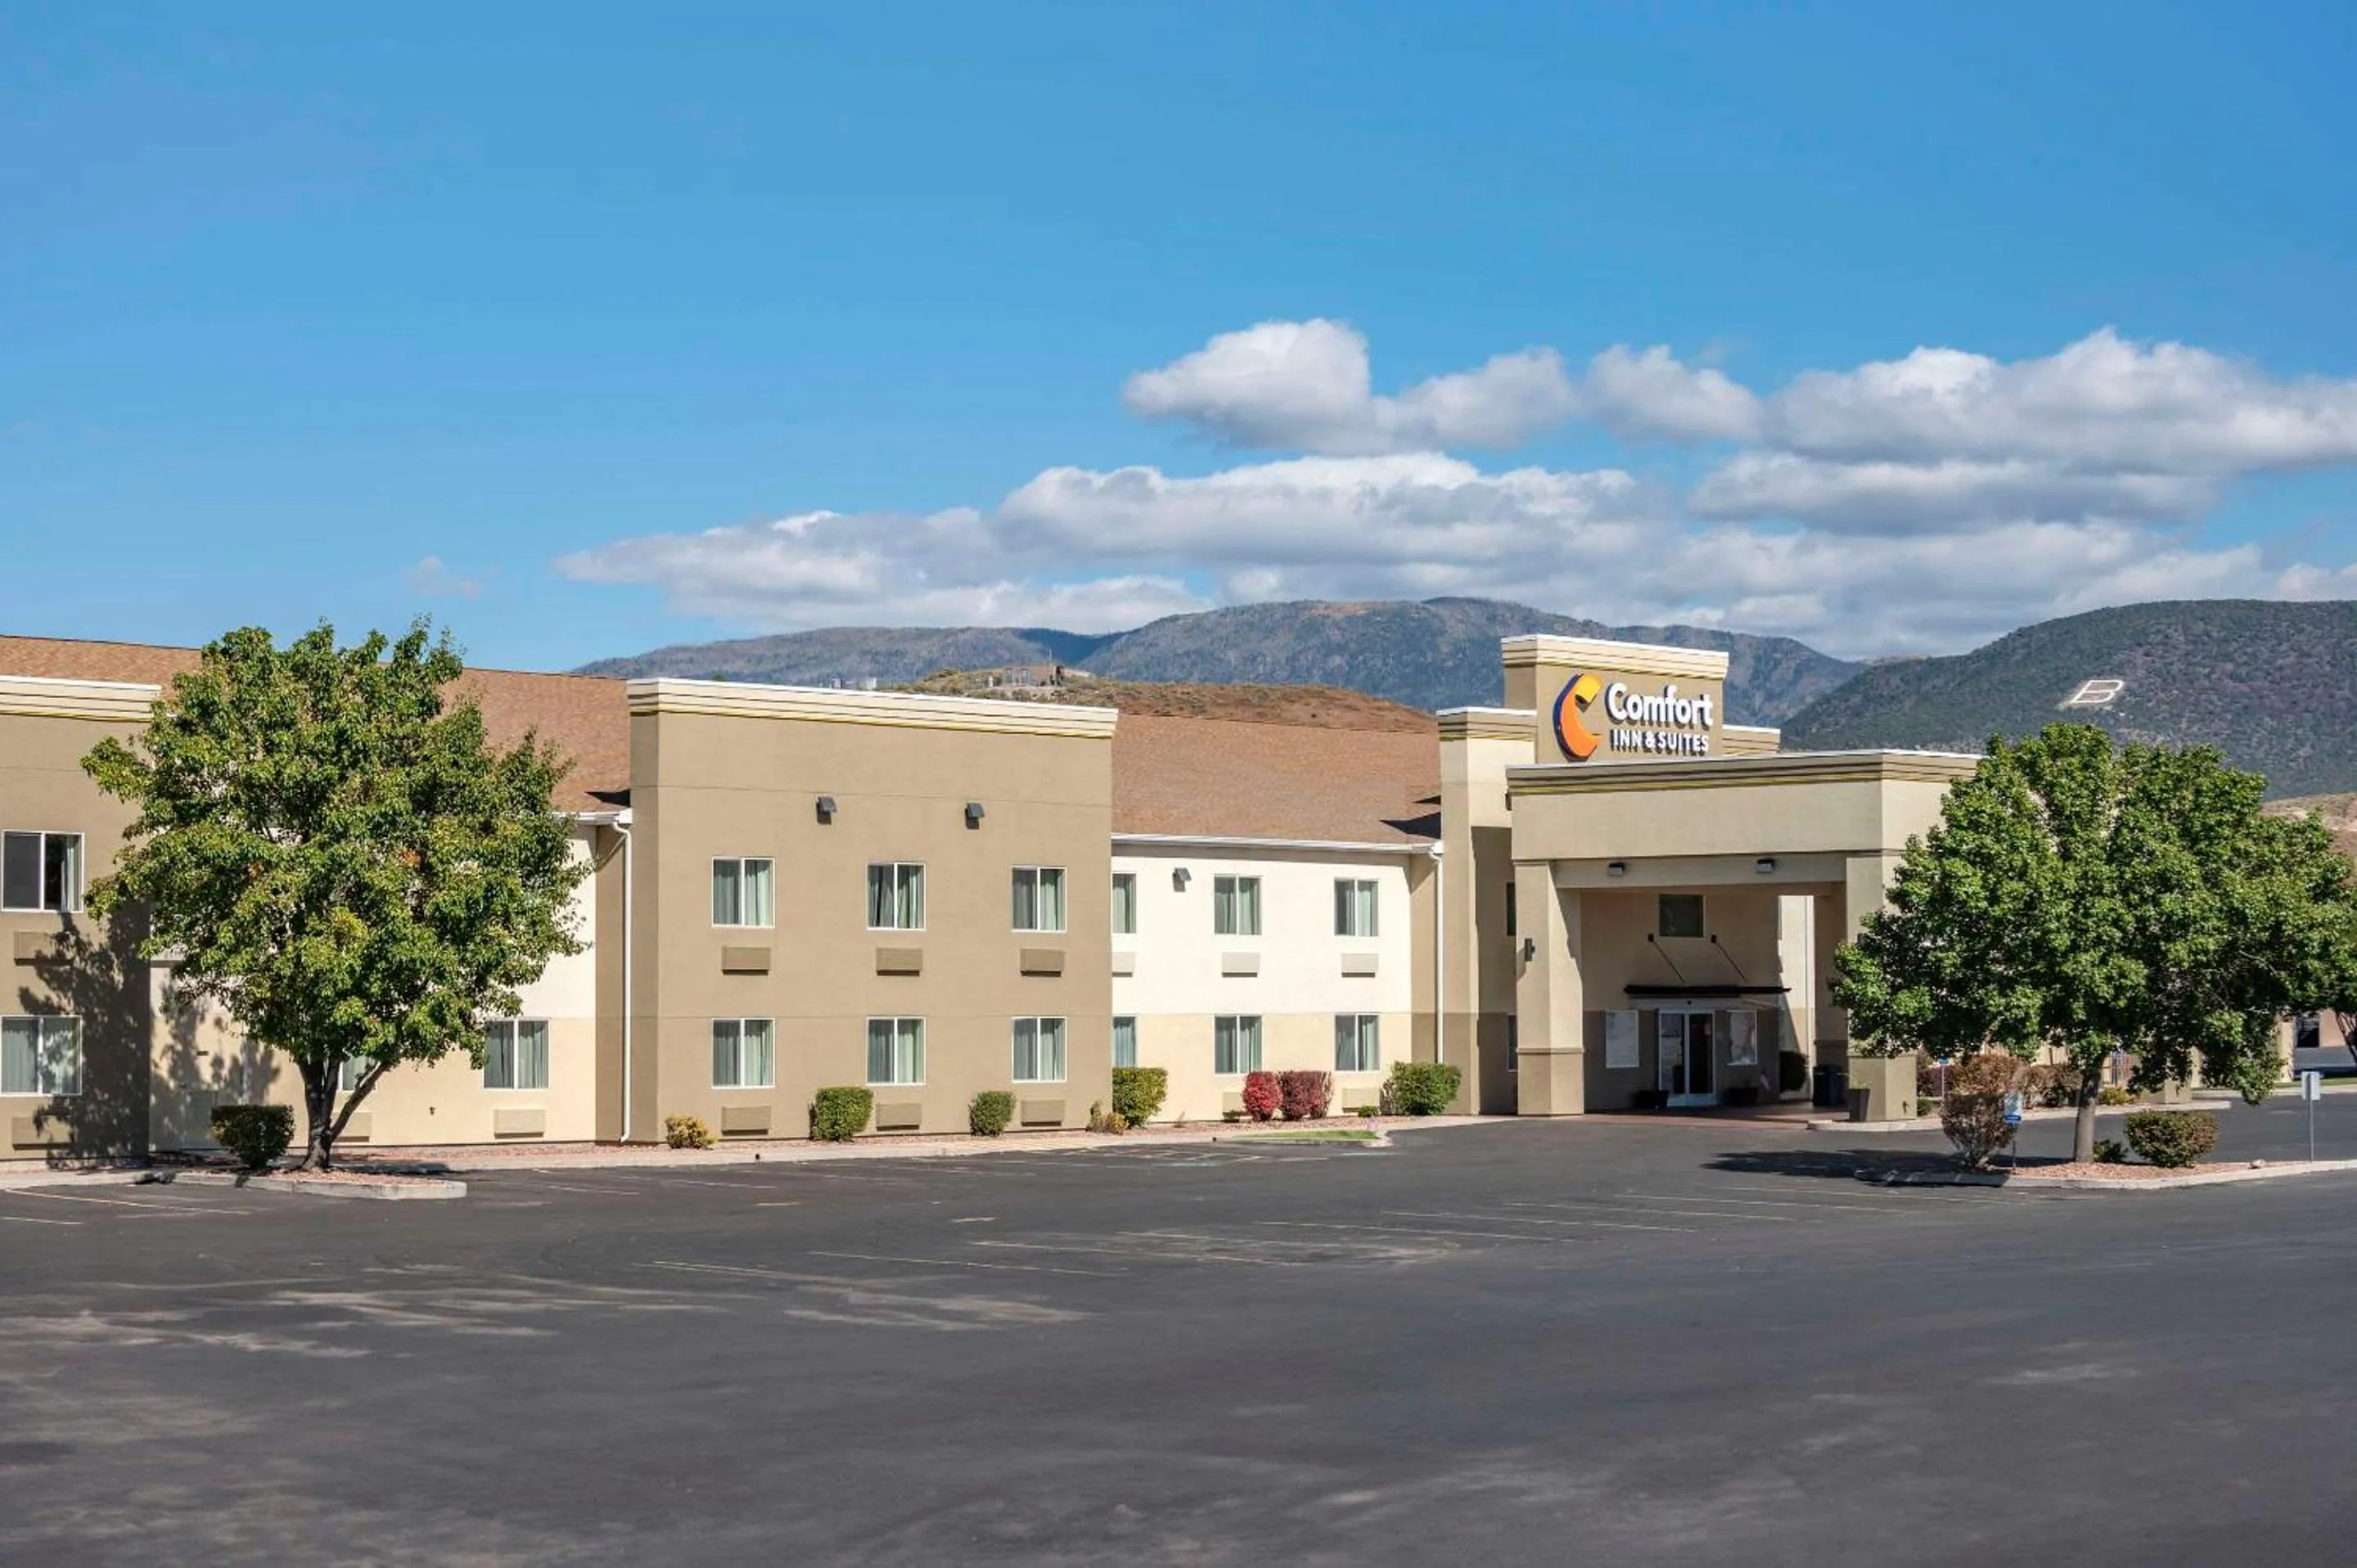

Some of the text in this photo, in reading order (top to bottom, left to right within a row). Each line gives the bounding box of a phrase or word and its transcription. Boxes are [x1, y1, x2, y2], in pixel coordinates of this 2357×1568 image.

[1607, 682, 1714, 727] Comfort
[1611, 728, 1709, 752] INN & SUITES
